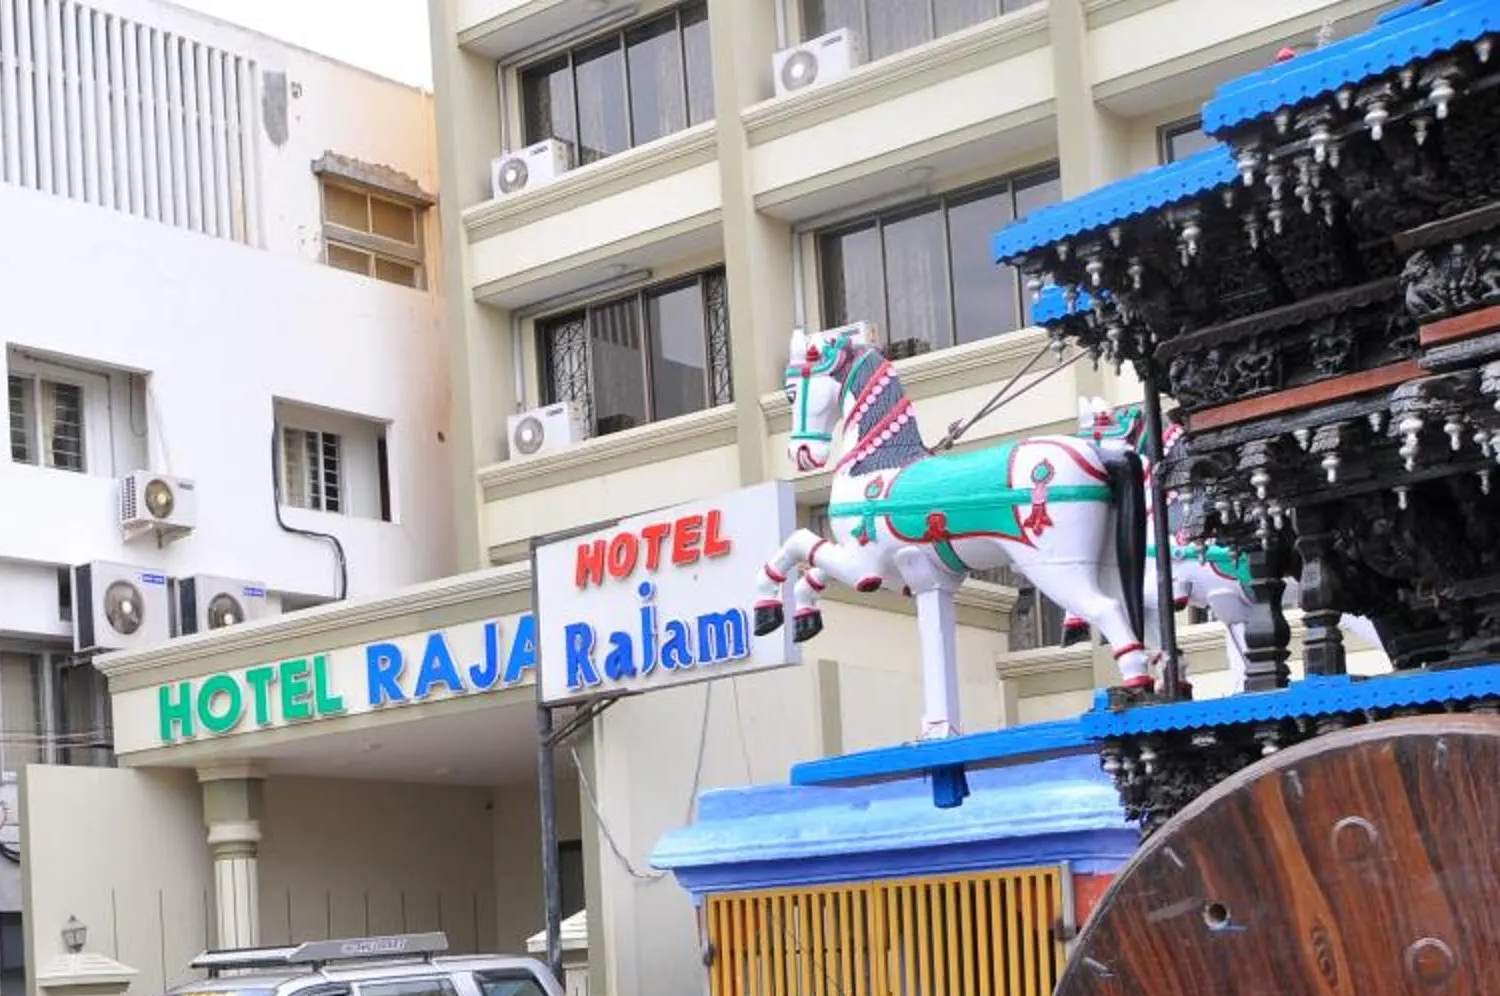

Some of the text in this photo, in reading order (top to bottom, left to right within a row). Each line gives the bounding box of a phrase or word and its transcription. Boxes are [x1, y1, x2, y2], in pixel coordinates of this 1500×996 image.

[575, 509, 731, 589] HOTEL
[565, 581, 749, 690] Rajam
[159, 653, 345, 743] HOTEL
